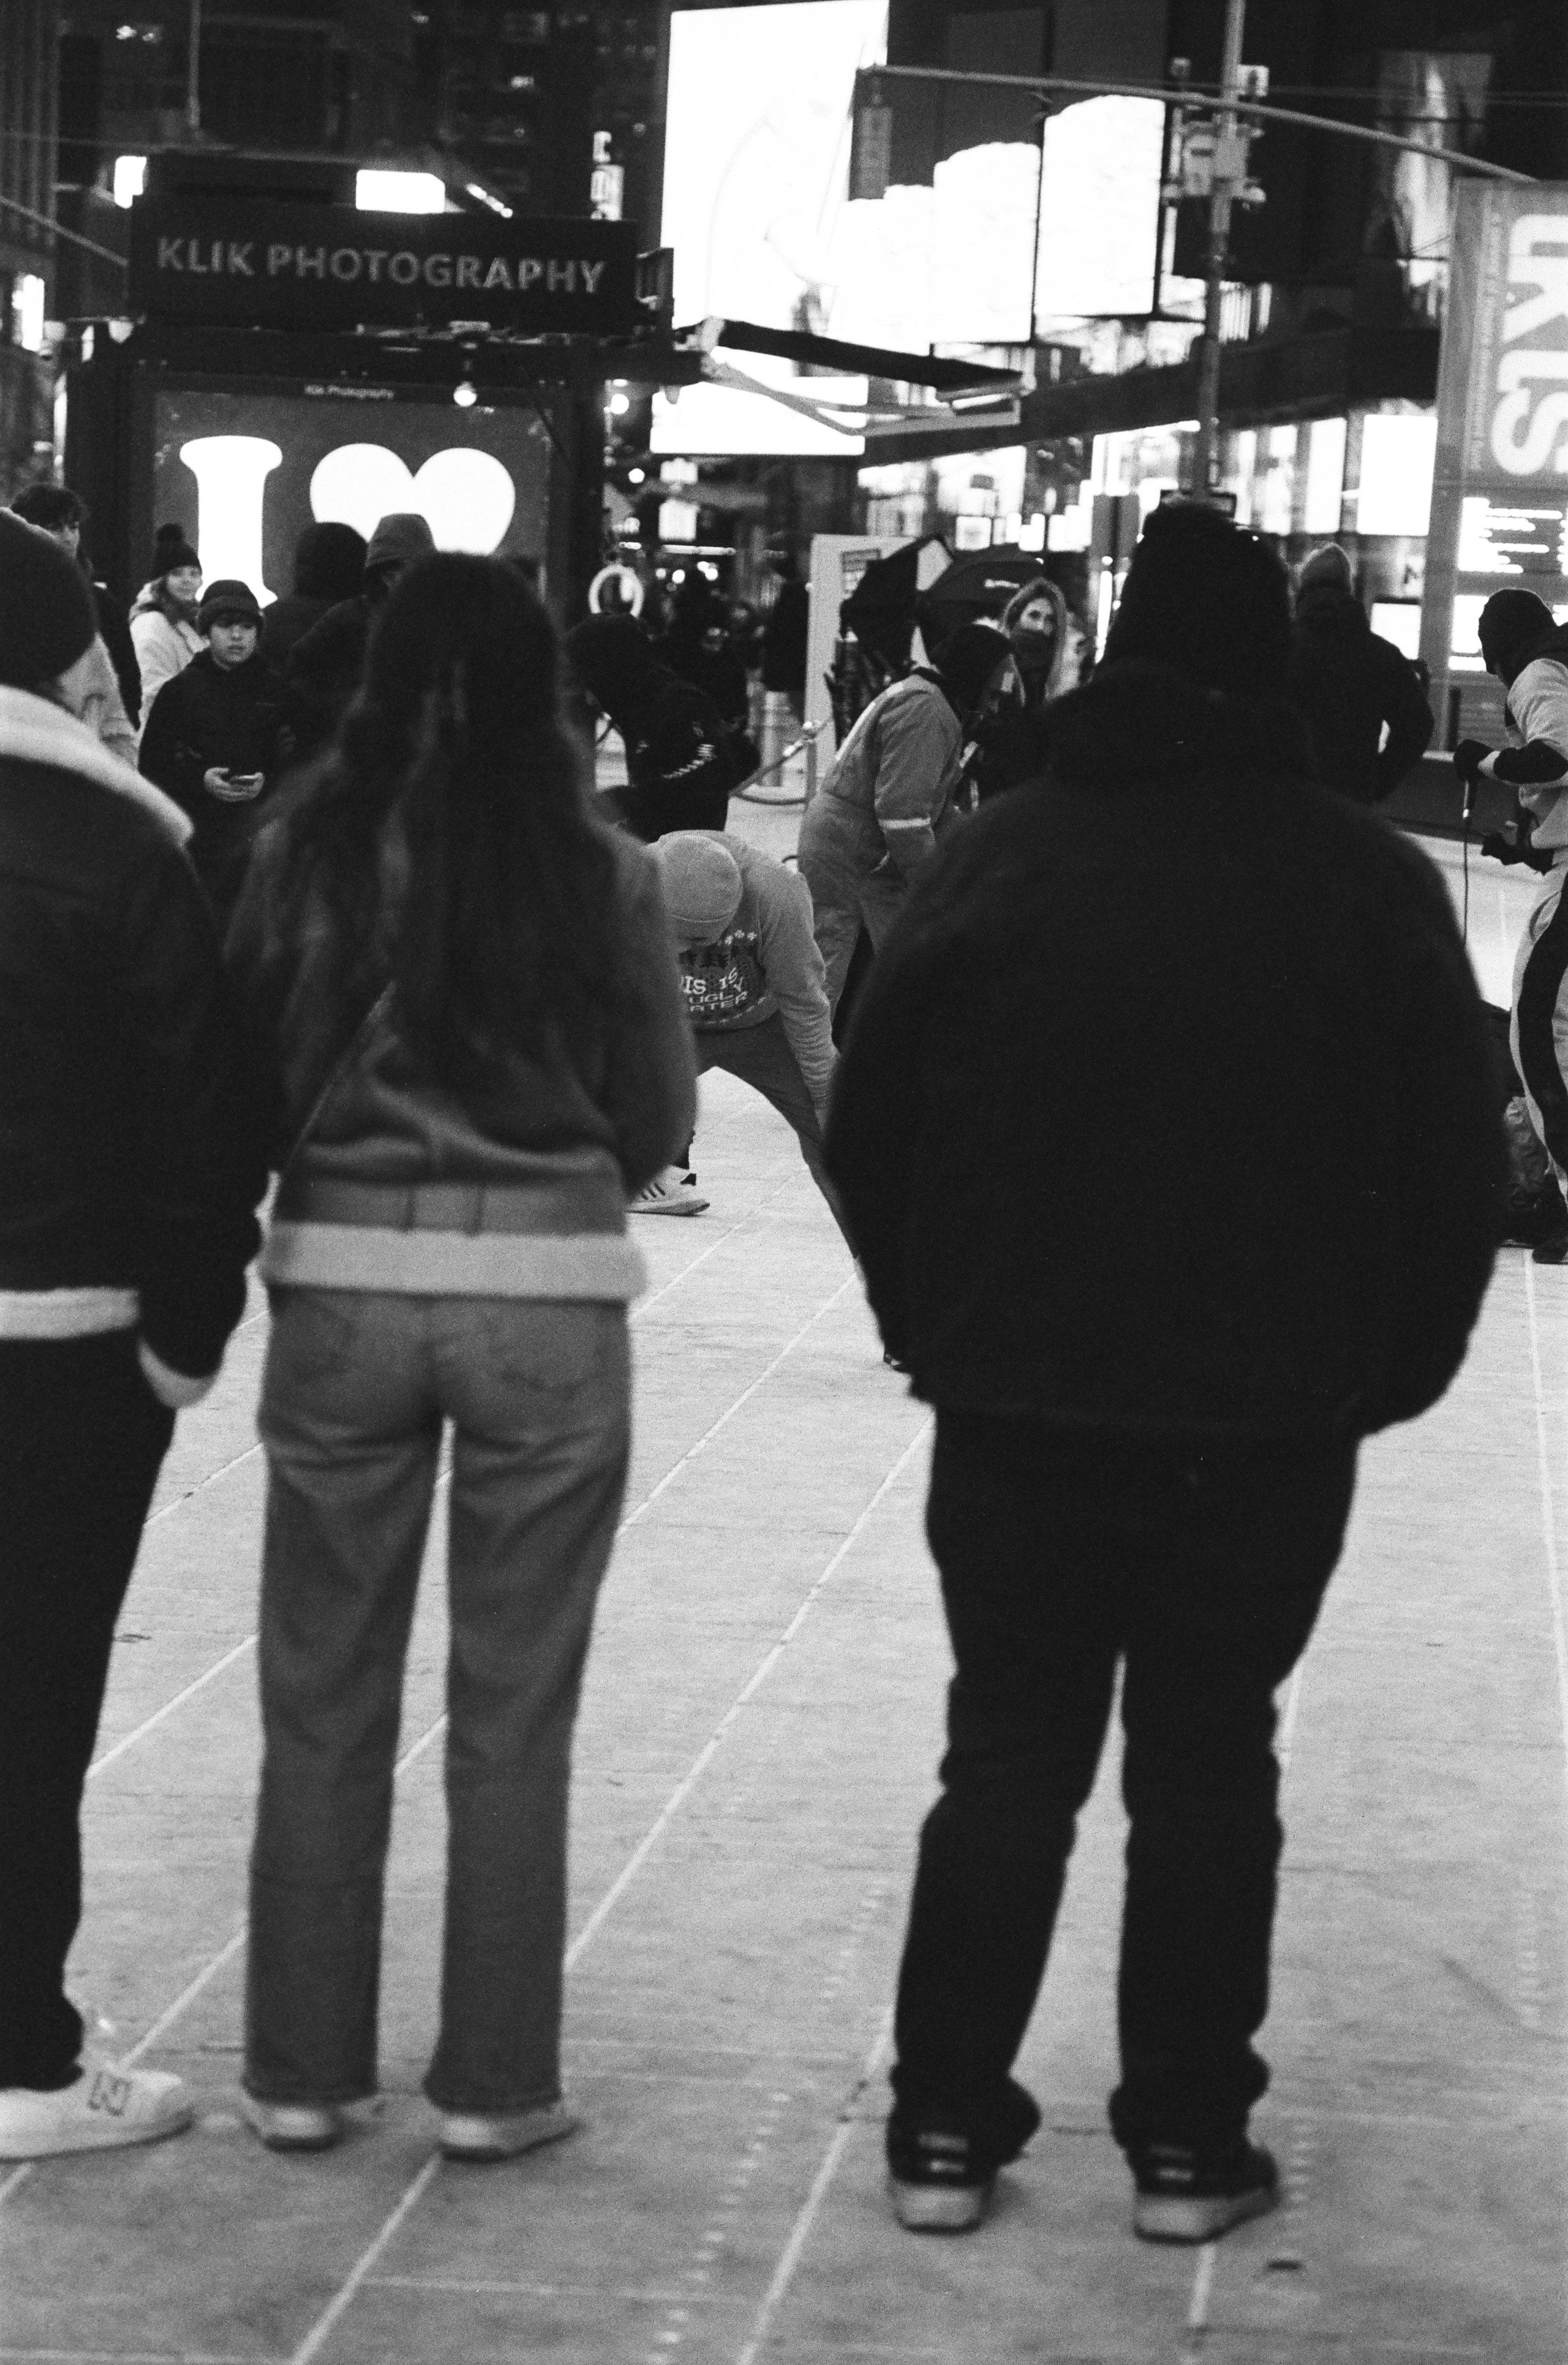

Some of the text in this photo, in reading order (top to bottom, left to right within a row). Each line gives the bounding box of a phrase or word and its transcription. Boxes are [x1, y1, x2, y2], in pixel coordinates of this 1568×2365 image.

[157, 237, 606, 293] KLIK PHOTOGRAPHY
[690, 990, 747, 1012] ATER
